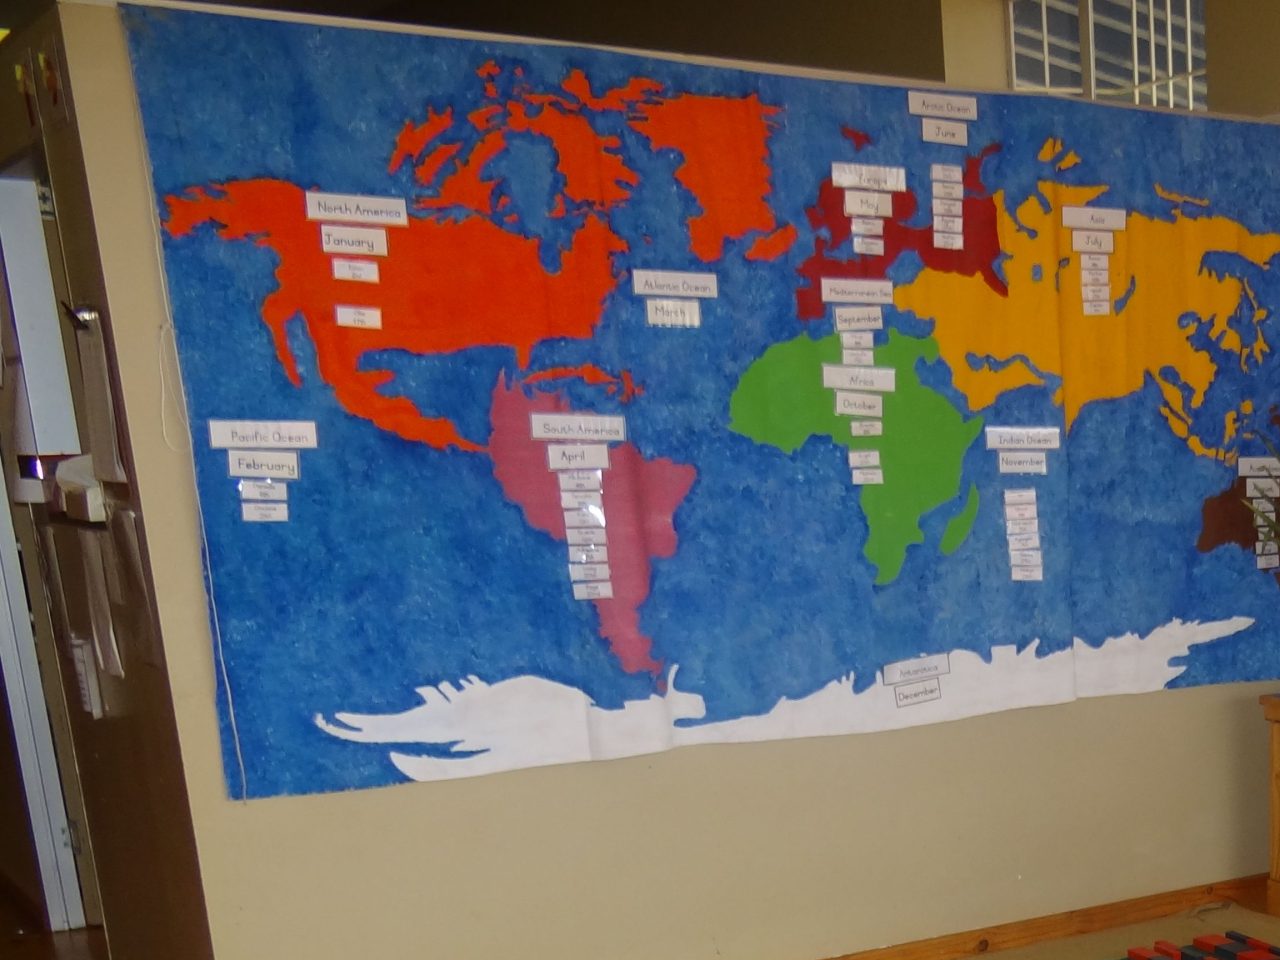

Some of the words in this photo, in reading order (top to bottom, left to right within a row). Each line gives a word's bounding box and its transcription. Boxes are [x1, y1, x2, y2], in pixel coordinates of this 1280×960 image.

[946, 102, 971, 114] Ocean
[935, 126, 956, 139] June
[317, 201, 352, 216] North
[355, 203, 401, 219] America
[860, 199, 879, 214] May
[324, 233, 374, 252] January
[1084, 235, 1103, 248] July
[681, 280, 711, 293] Ocean
[655, 305, 686, 319] March
[842, 398, 877, 411] October
[542, 423, 574, 435] South
[577, 424, 620, 436] America
[230, 430, 269, 443] Pacific
[272, 431, 309, 444] Ocean
[998, 434, 1025, 446] Indian
[1026, 435, 1052, 446] Ocean
[560, 450, 586, 464] April
[1001, 456, 1044, 467] November
[237, 457, 296, 476] February
[898, 687, 938, 701] December
